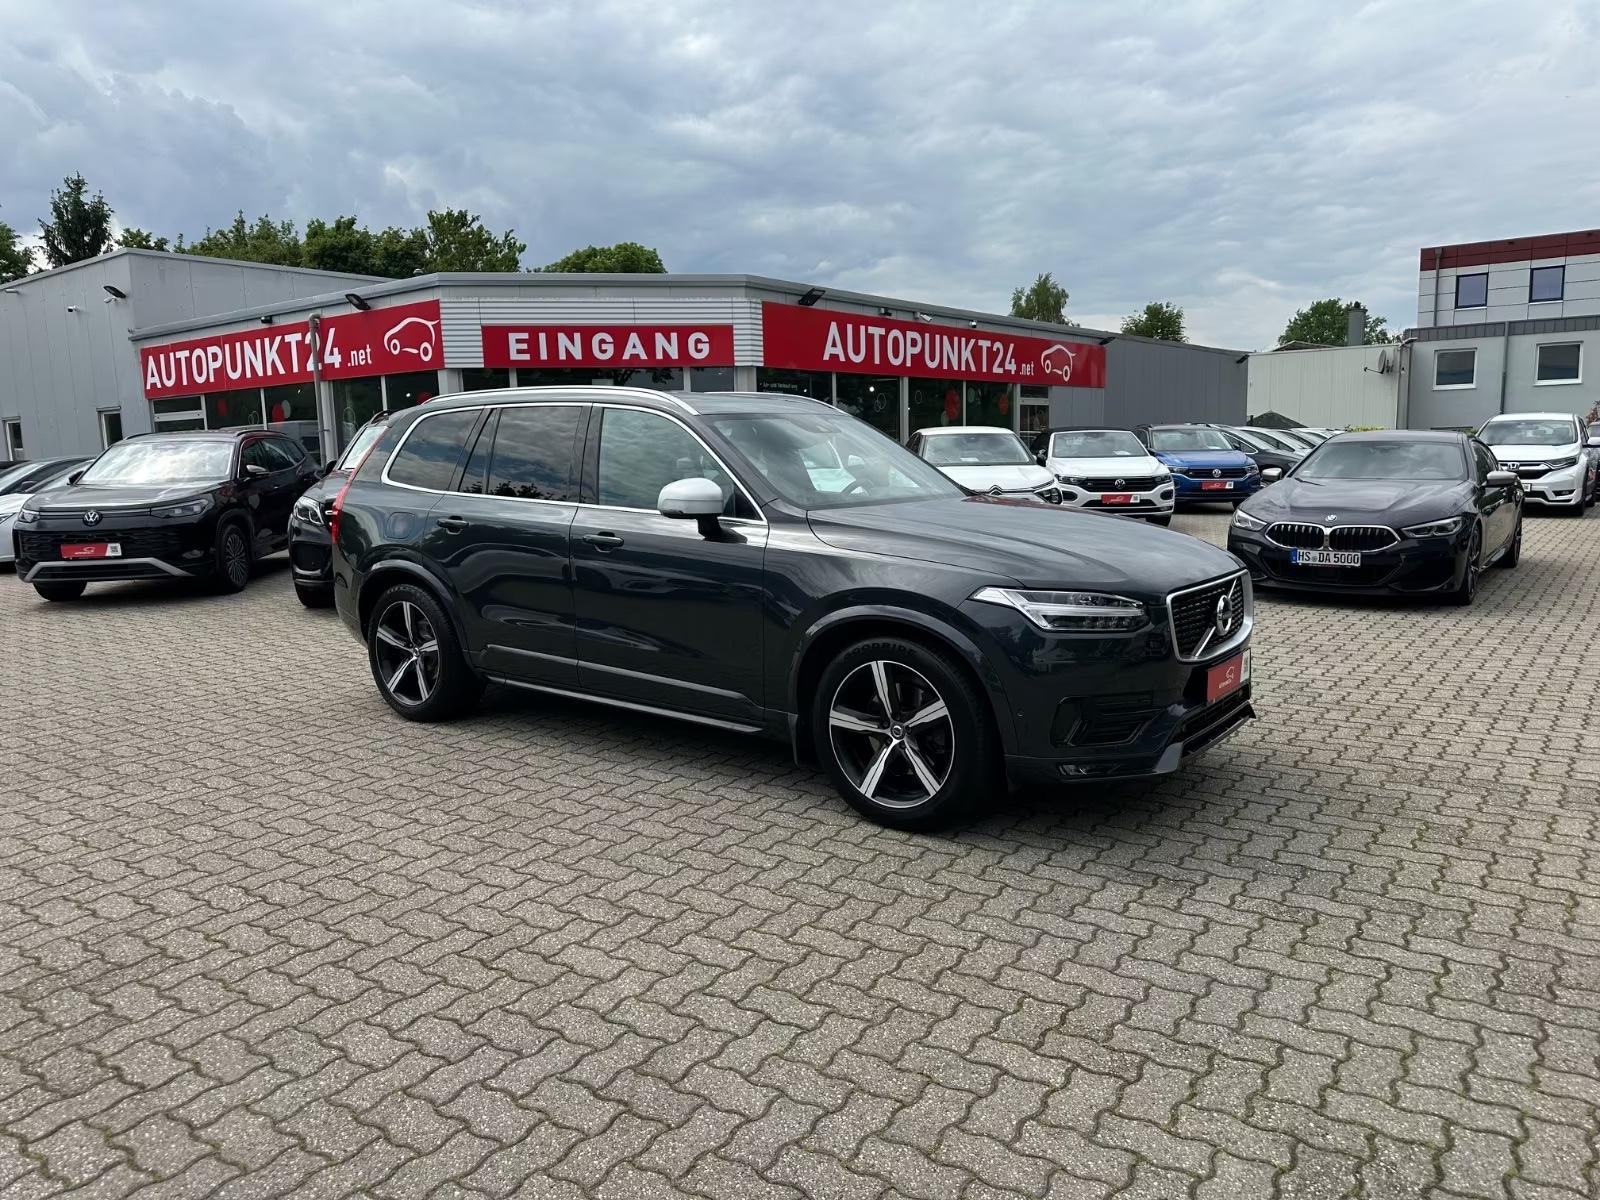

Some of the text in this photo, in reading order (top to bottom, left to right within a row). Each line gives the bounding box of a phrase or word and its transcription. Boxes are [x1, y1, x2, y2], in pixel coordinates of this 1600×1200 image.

[146, 327, 373, 391] AUTOPUNKT24 .net
[508, 331, 710, 361] EINGANG
[823, 320, 1035, 376] AUTOPUNKT24 .net
[1298, 551, 1359, 564] HS DA 5000
